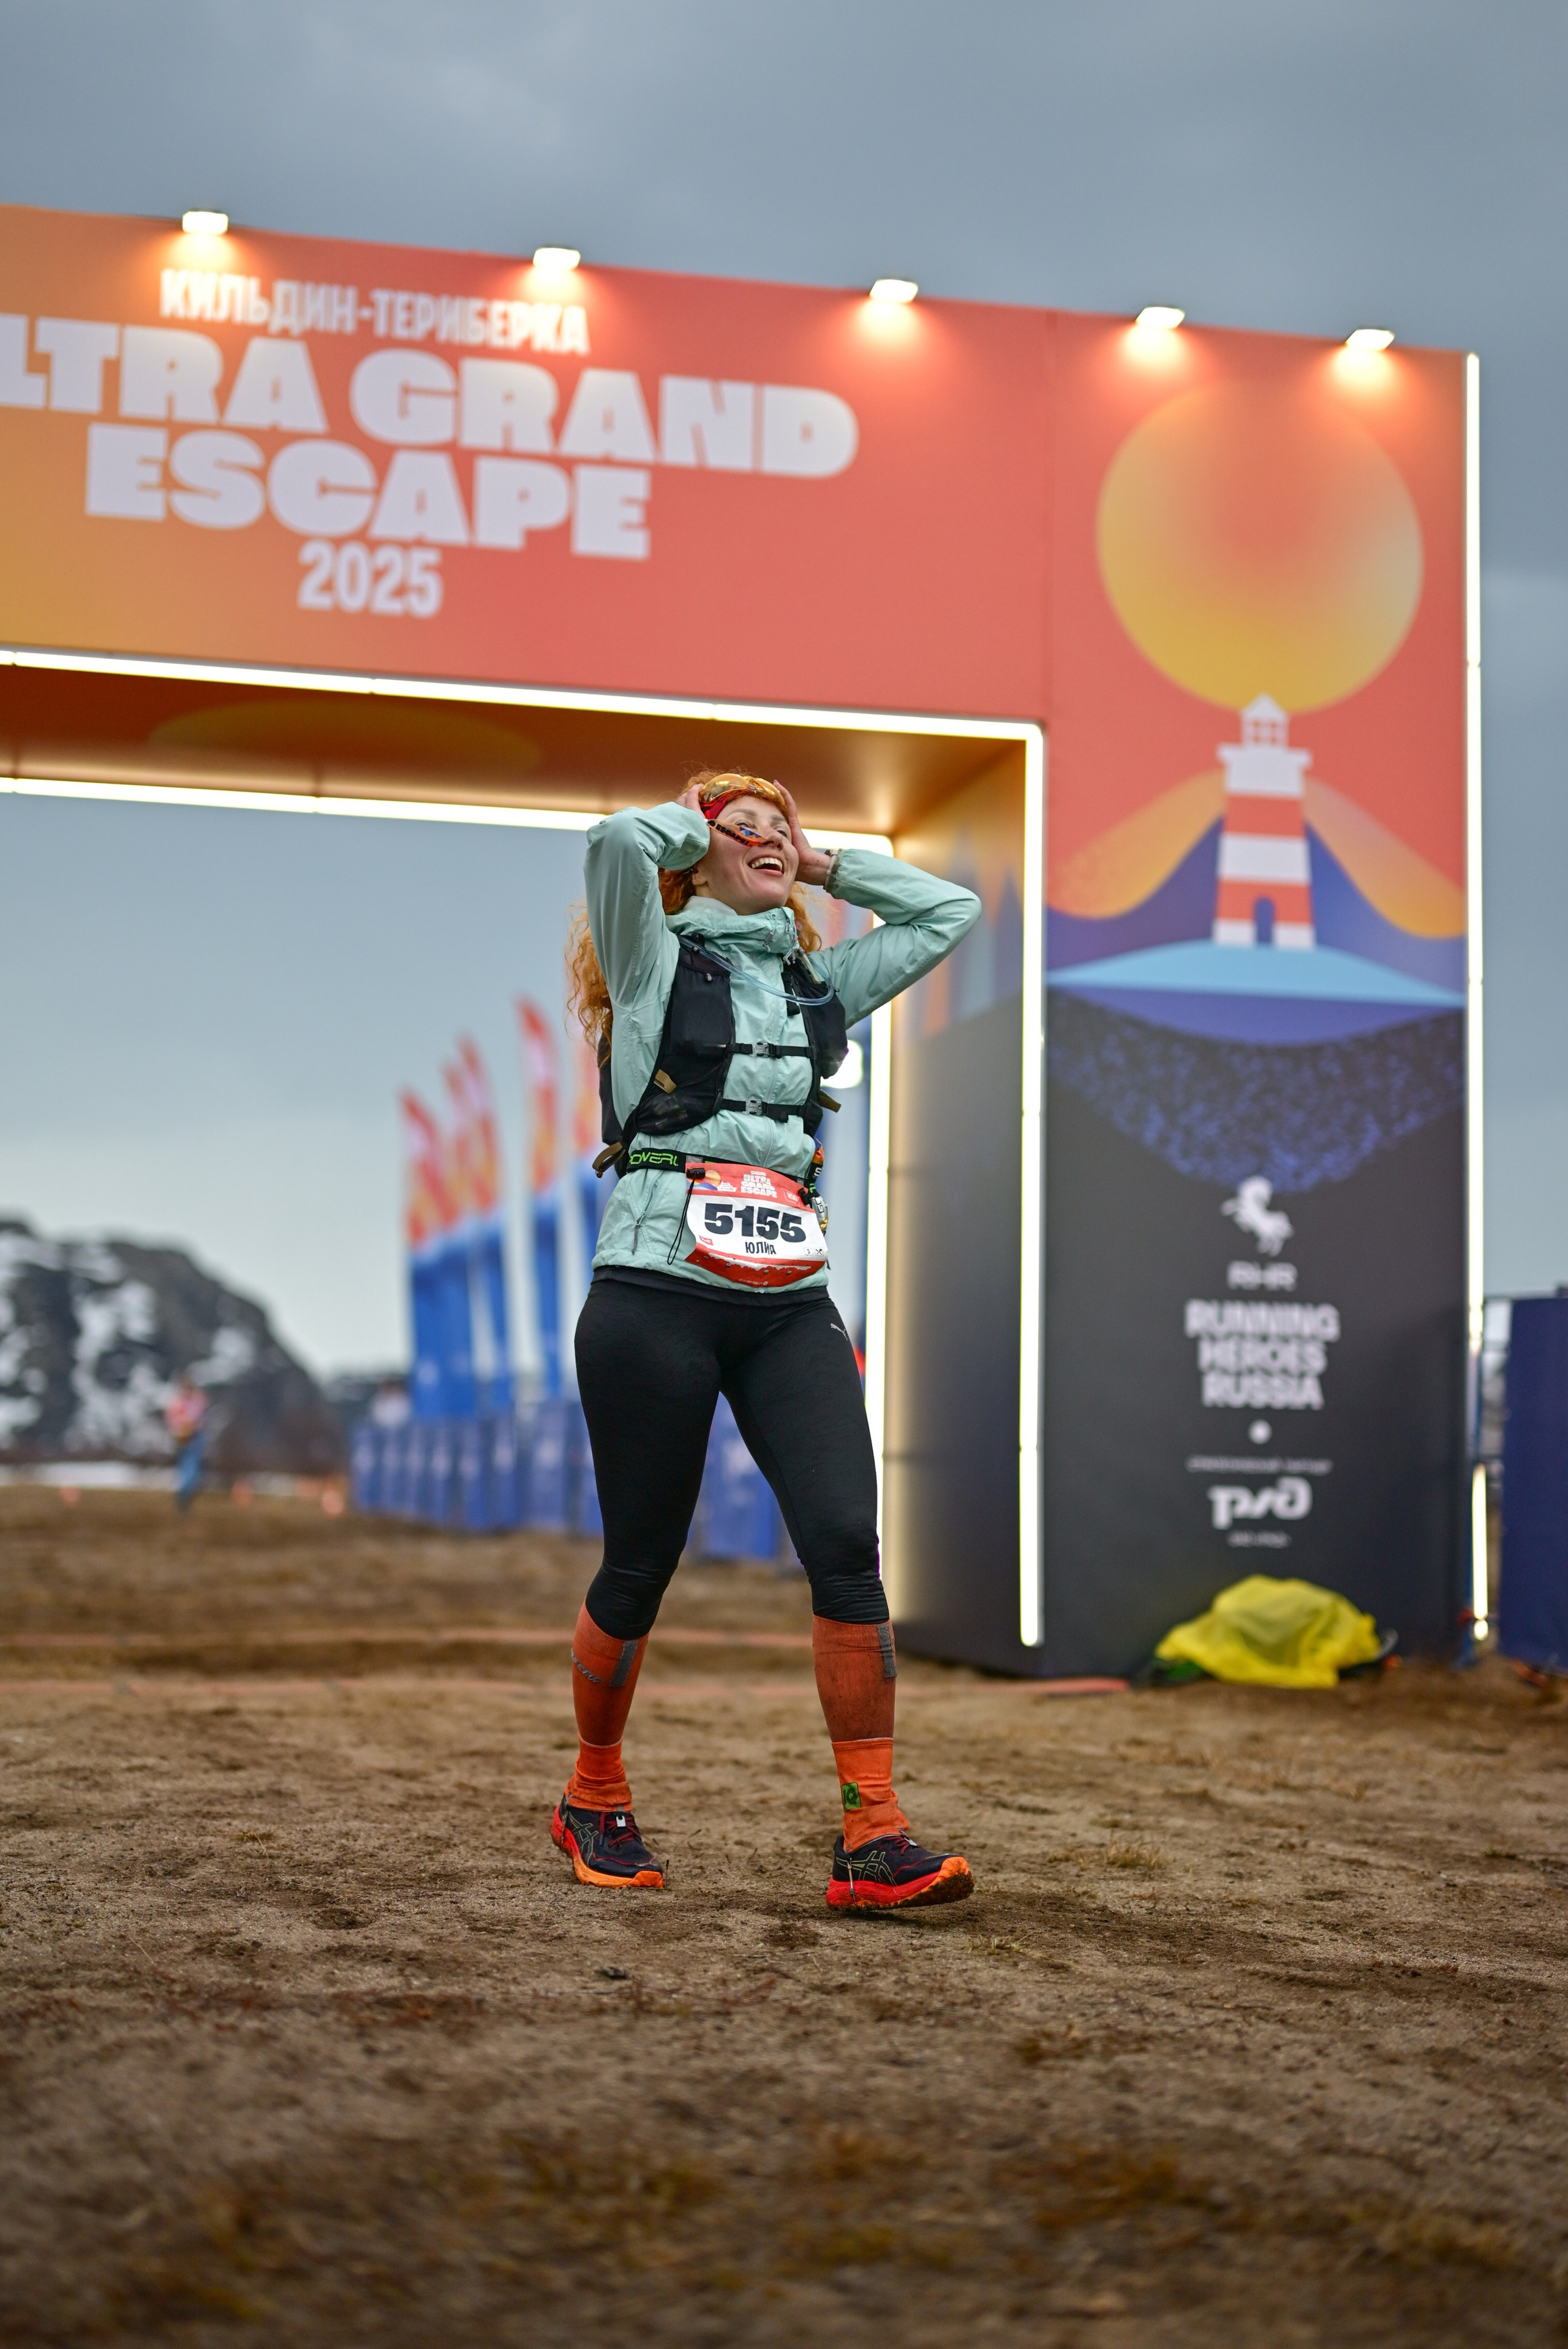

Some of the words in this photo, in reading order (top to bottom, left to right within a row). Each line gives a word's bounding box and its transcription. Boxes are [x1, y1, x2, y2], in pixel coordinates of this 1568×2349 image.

[349, 347, 859, 478] GRAND
[85, 422, 651, 561] ESCAPE
[297, 539, 443, 618] 2025
[741, 1181, 775, 1191] GRAND
[741, 1186, 778, 1198] ESCAPE
[743, 1174, 772, 1186] ULTRA
[704, 1203, 806, 1243] 5155
[745, 1241, 777, 1255] ЮЛИЯ
[1185, 1299, 1341, 1342] RUNNING
[1197, 1337, 1328, 1376] HEROES
[1202, 1373, 1324, 1409] RUSSIA
